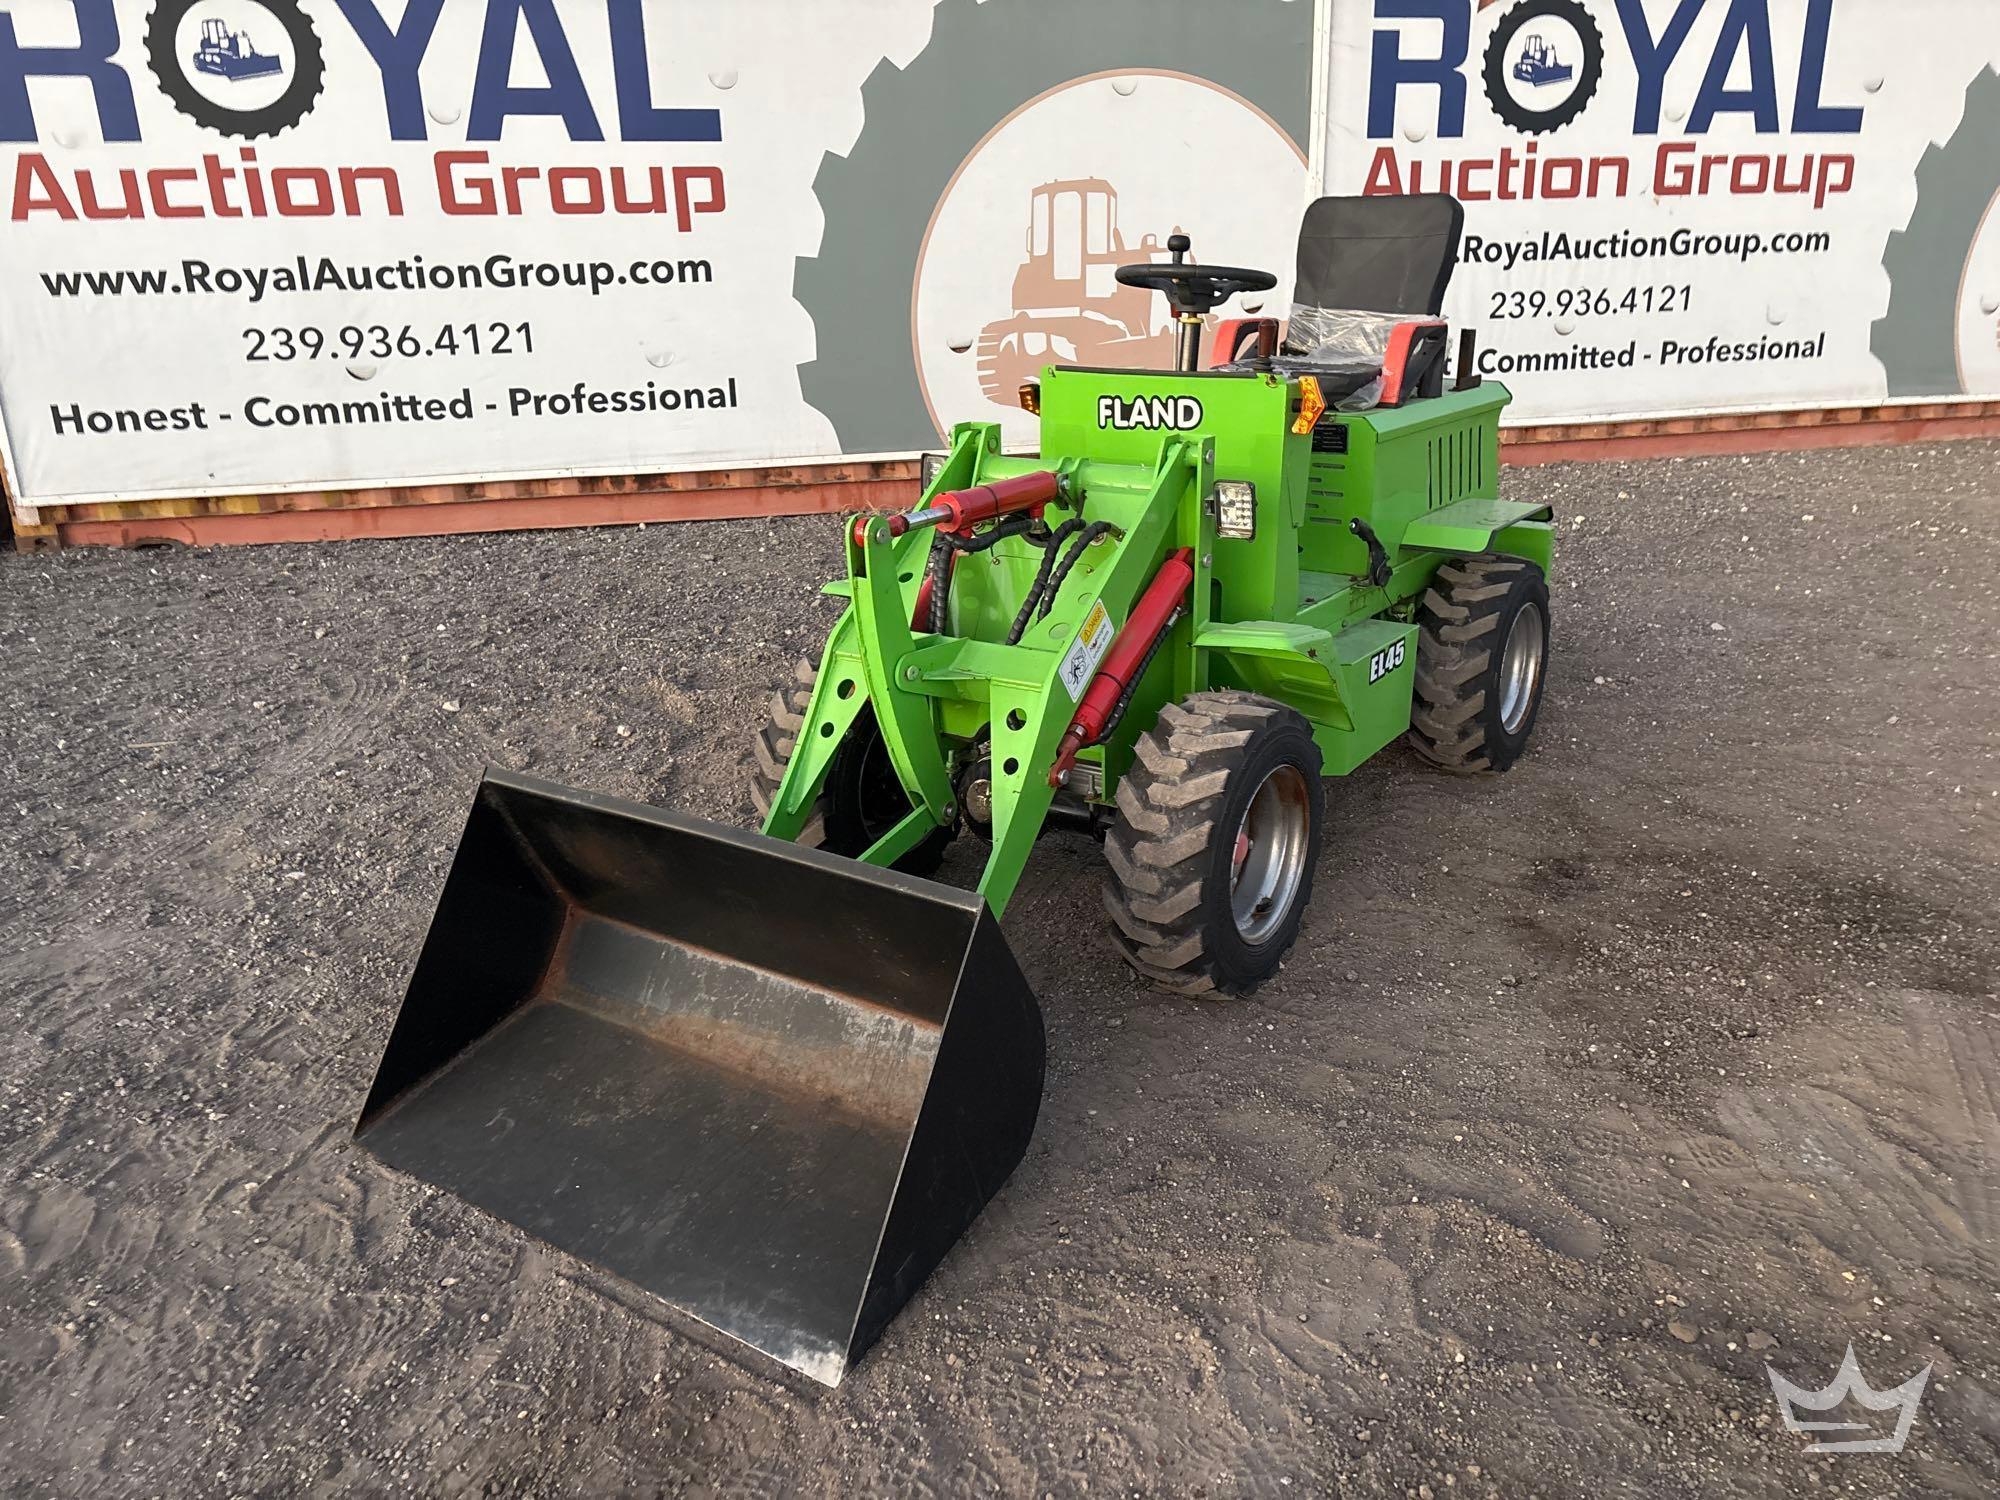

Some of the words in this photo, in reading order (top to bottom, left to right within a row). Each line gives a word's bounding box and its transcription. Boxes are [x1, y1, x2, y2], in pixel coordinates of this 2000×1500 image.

[0, 0, 723, 142] ROYAL
[1366, 0, 1864, 139] ROYAL
[11, 147, 404, 221] Auction
[433, 150, 726, 232] Group
[1362, 141, 1629, 200] Auction
[1653, 142, 1855, 209] Group
[1454, 228, 1830, 271] .RoyalAuctionGroup.com
[40, 254, 713, 302] www.RoyalAuctionGroup.com
[1489, 285, 1692, 319] 239.936.4121
[242, 322, 535, 361] 239.936.4121
[1477, 338, 1635, 374] Committed
[1660, 332, 1825, 365] Professional
[50, 403, 208, 435] Honest
[244, 388, 474, 428] Committed
[508, 378, 738, 417] Professional
[1098, 395, 1203, 431] FLAND
[1369, 636, 1405, 685] EL45
